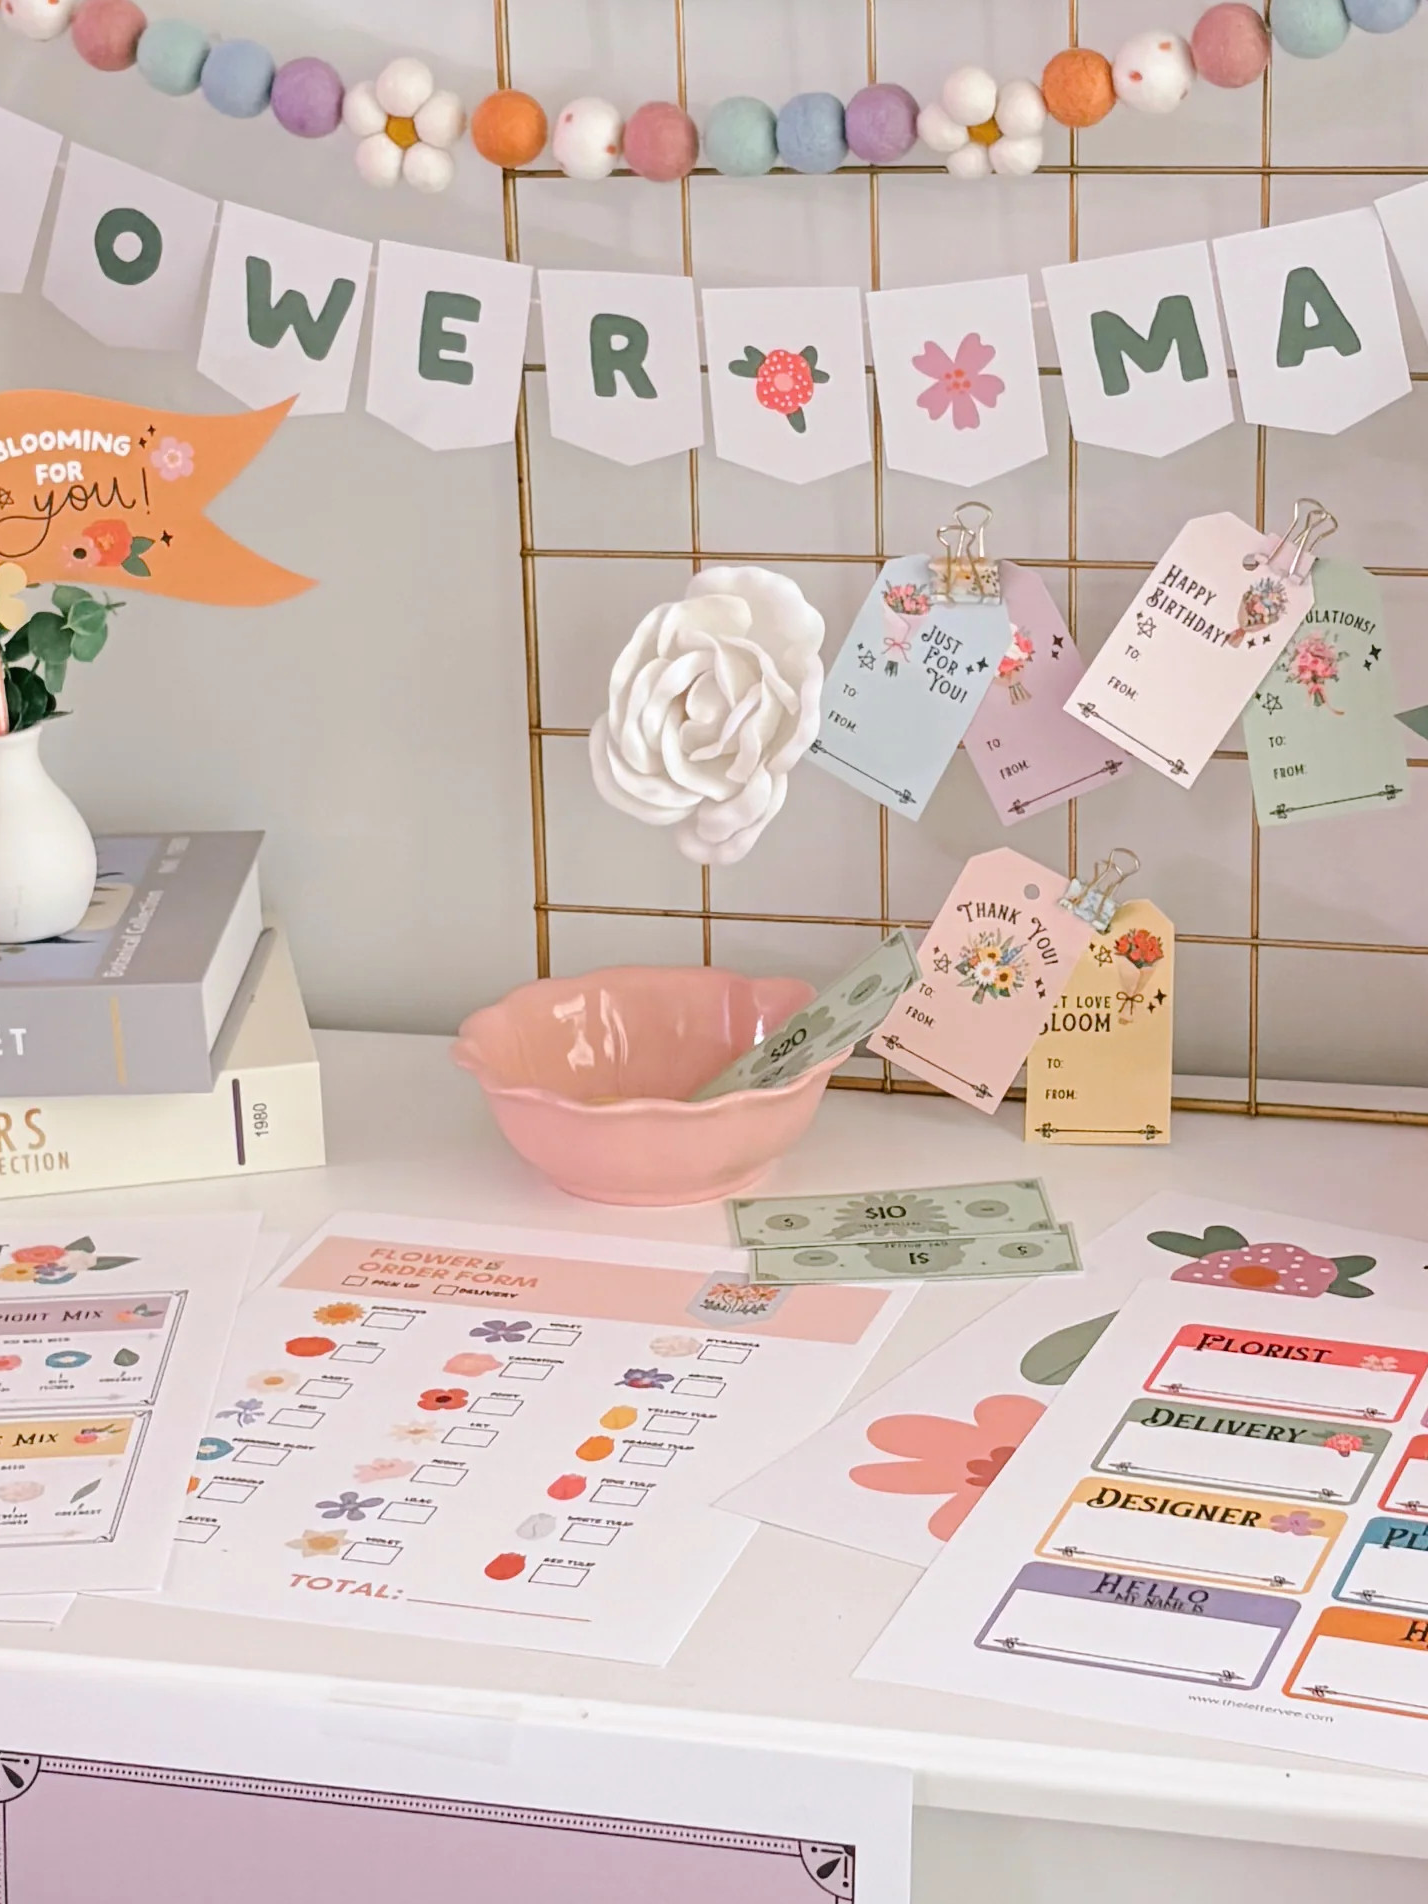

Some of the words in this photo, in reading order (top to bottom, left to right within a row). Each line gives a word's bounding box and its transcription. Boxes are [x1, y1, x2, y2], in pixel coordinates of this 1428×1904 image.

[35, 461, 84, 486] FOR
[1159, 564, 1217, 607] HAPPY
[1146, 587, 1231, 648] BIRTHDAY!
[1301, 609, 1376, 636] ULATIONS!
[921, 625, 963, 655] JUST
[923, 646, 959, 676] FOR
[926, 668, 968, 704] YOU!
[957, 901, 1023, 926] THANK
[1027, 916, 1060, 967] YOU!
[1075, 994, 1111, 1010] LOVE
[1039, 1012, 1112, 1036] LOOM
[769, 1027, 807, 1063] $20
[252, 1101, 272, 1139] 1980
[865, 1205, 907, 1220] $10
[370, 1247, 478, 1271] FLOWER
[358, 1261, 450, 1281] ORDER
[454, 1269, 539, 1289] FORM
[458, 1287, 519, 1299] DELIVERY
[61, 1310, 105, 1323] MIX
[1193, 1332, 1332, 1363] FLORIST
[1140, 1407, 1307, 1443] DELIVERY
[12, 1432, 60, 1448] MIX
[1086, 1487, 1262, 1528] DESIGNER
[289, 1573, 404, 1600] TOTAL:
[1093, 1572, 1210, 1604] HELLO
[1114, 1591, 1142, 1604] MY
[1145, 1595, 1190, 1612] NAME
